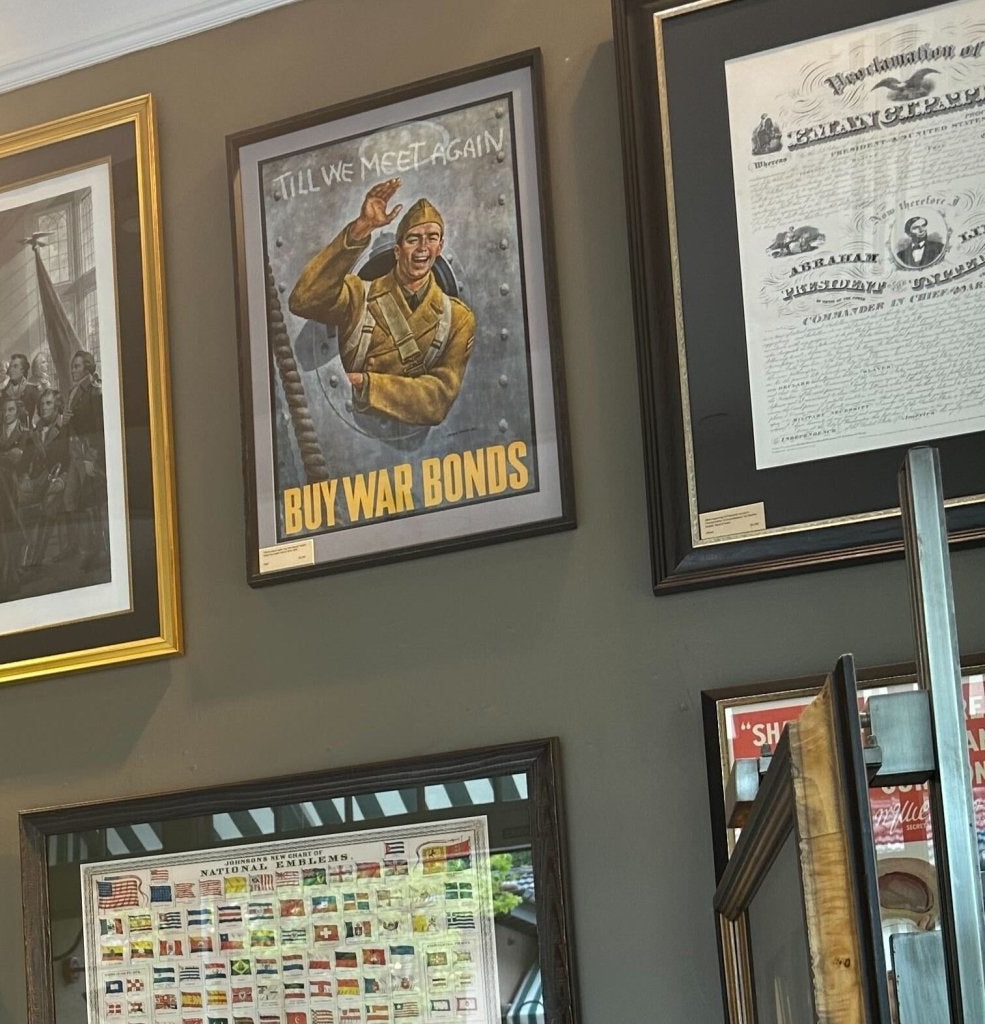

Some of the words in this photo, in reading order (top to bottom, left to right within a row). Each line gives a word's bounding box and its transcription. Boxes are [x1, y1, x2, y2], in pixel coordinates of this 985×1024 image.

[272, 168, 321, 201] TILL
[321, 160, 355, 186] WE
[360, 141, 427, 181] MEET
[430, 127, 504, 166] AGAIN
[789, 253, 879, 278] ABRAHAM
[782, 279, 887, 301] PRESIDENT
[803, 302, 885, 326] COMMANDER
[284, 479, 337, 535] BUY
[343, 463, 414, 522] WAR
[421, 441, 529, 508] BONDS
[200, 862, 267, 877] NATIONAL
